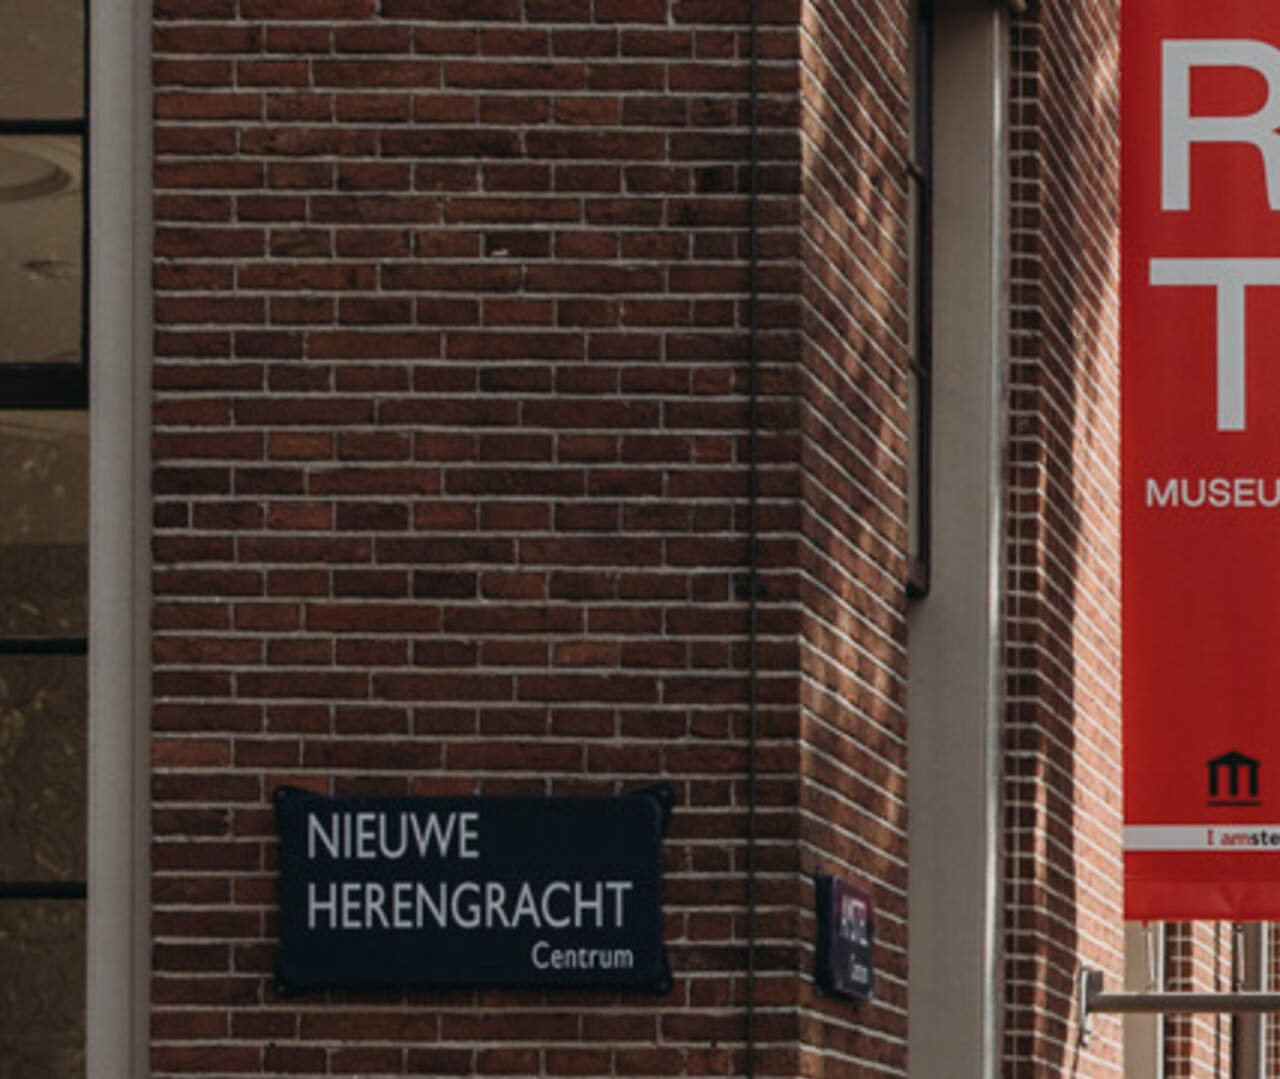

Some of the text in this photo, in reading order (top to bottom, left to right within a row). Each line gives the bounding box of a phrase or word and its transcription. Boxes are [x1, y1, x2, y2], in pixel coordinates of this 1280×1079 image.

[307, 812, 479, 859] NIEUWE
[1206, 829, 1215, 846] I
[308, 881, 633, 929] HERENGRACHT
[531, 940, 634, 969] Centrum
